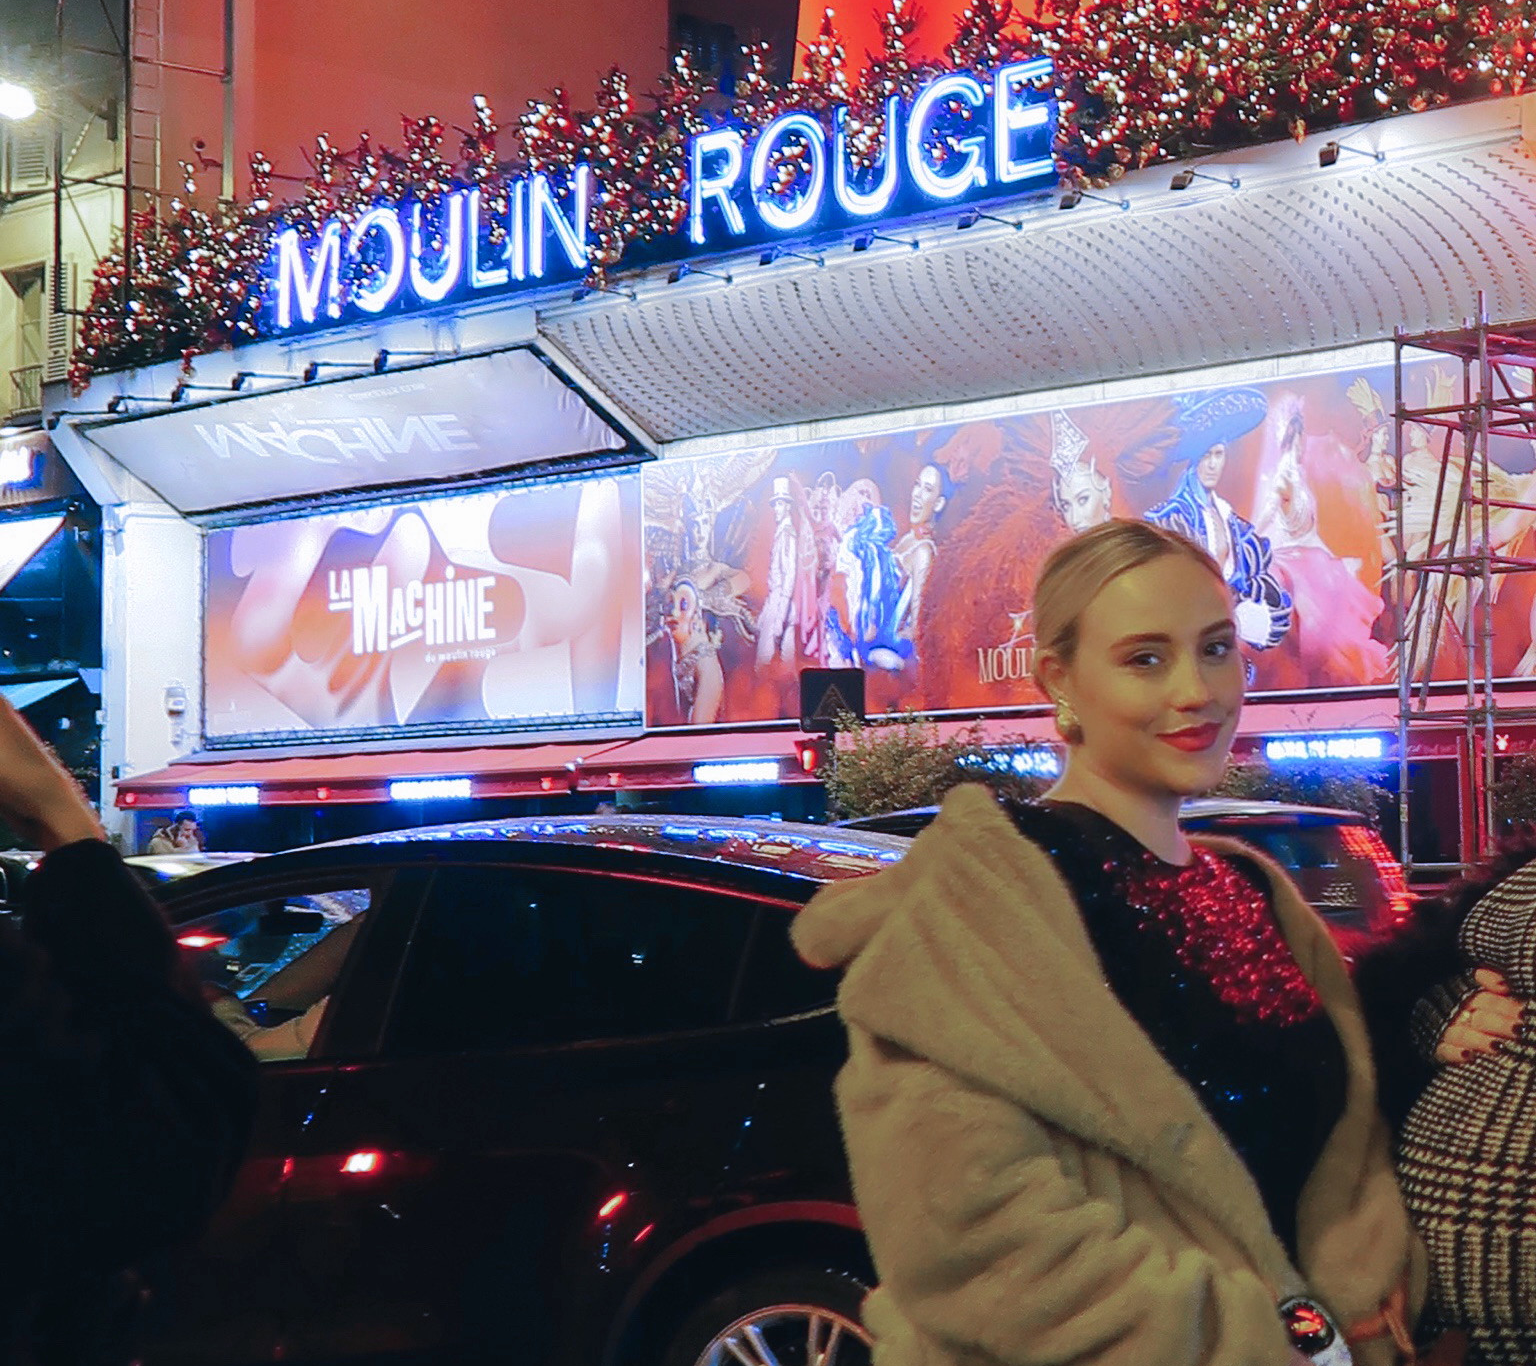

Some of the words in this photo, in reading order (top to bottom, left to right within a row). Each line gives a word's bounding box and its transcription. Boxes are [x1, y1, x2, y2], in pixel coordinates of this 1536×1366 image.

[276, 162, 591, 330] MOULIN
[690, 58, 1056, 245] ROUGE
[328, 569, 351, 601] LA
